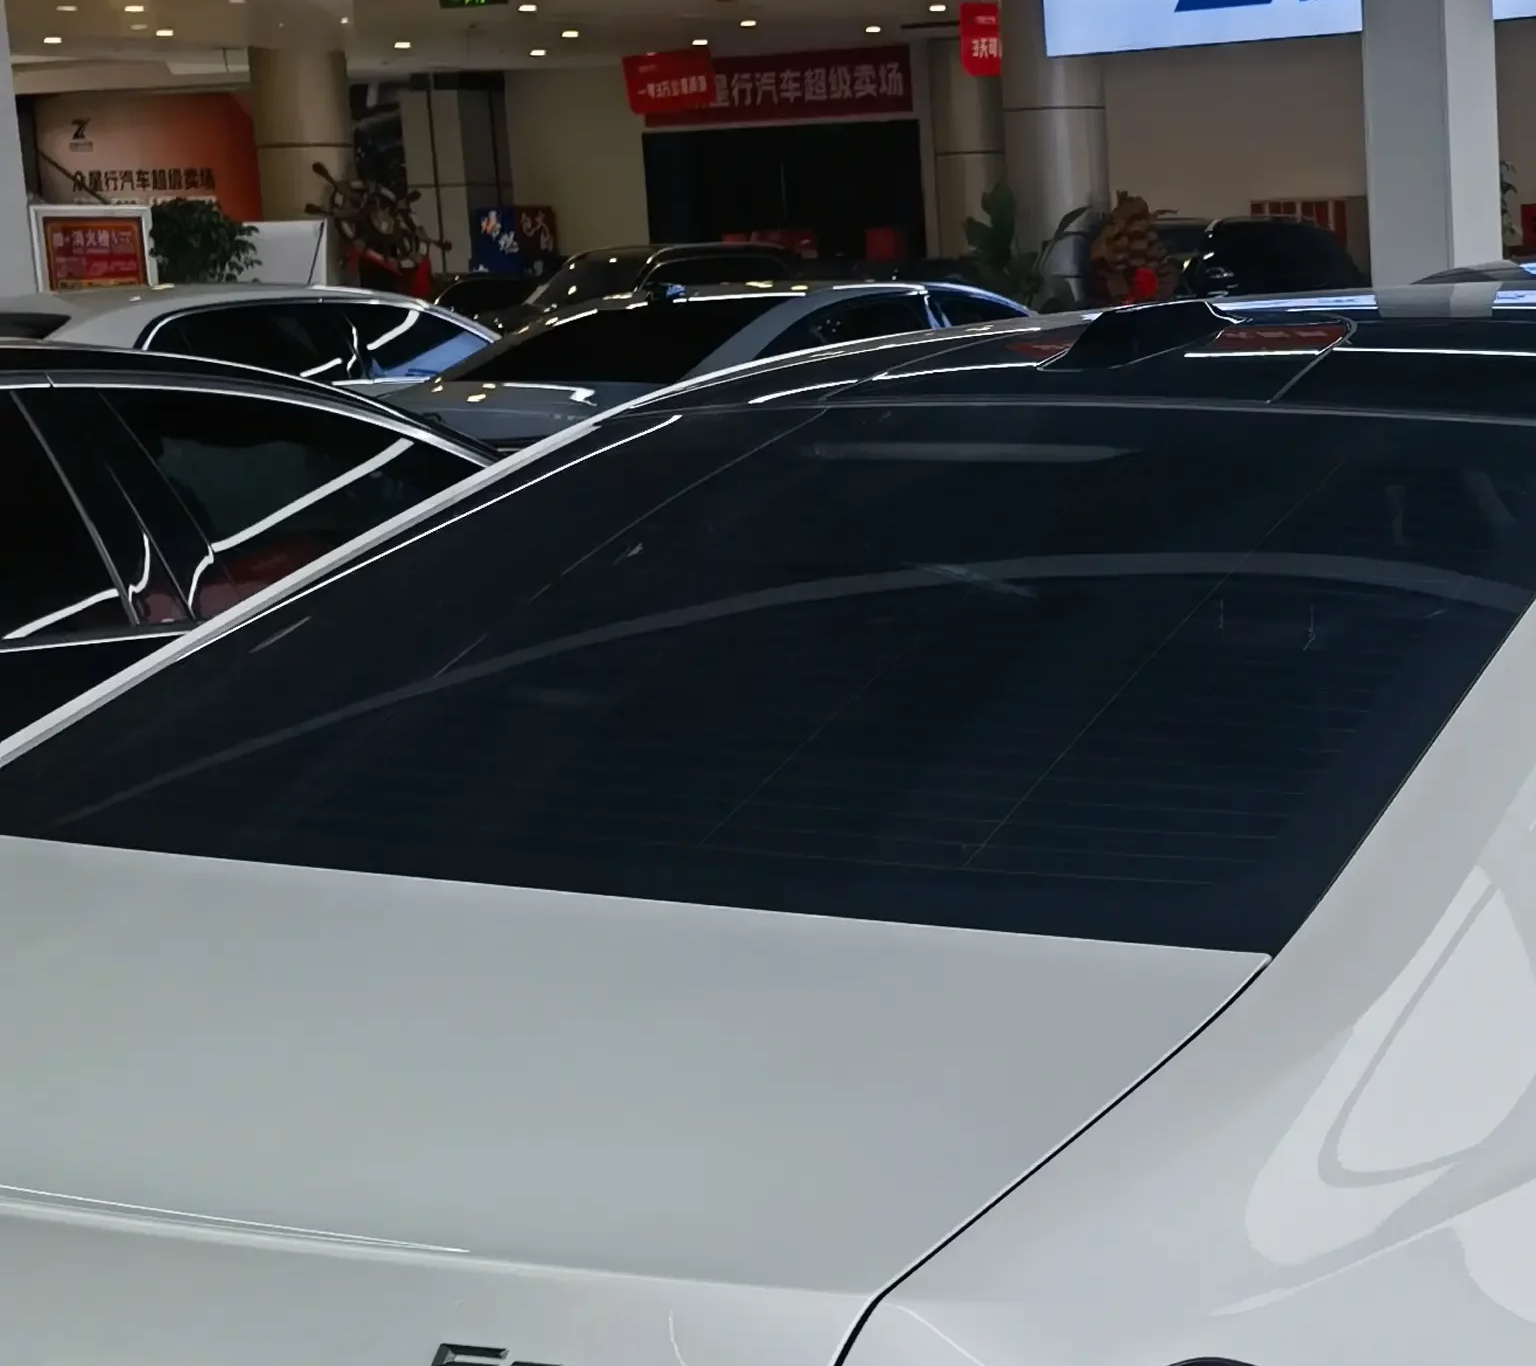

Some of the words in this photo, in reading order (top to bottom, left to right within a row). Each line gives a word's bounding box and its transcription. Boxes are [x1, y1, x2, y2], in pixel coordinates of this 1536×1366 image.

[695, 62, 904, 109] 星行汽车超级卖场
